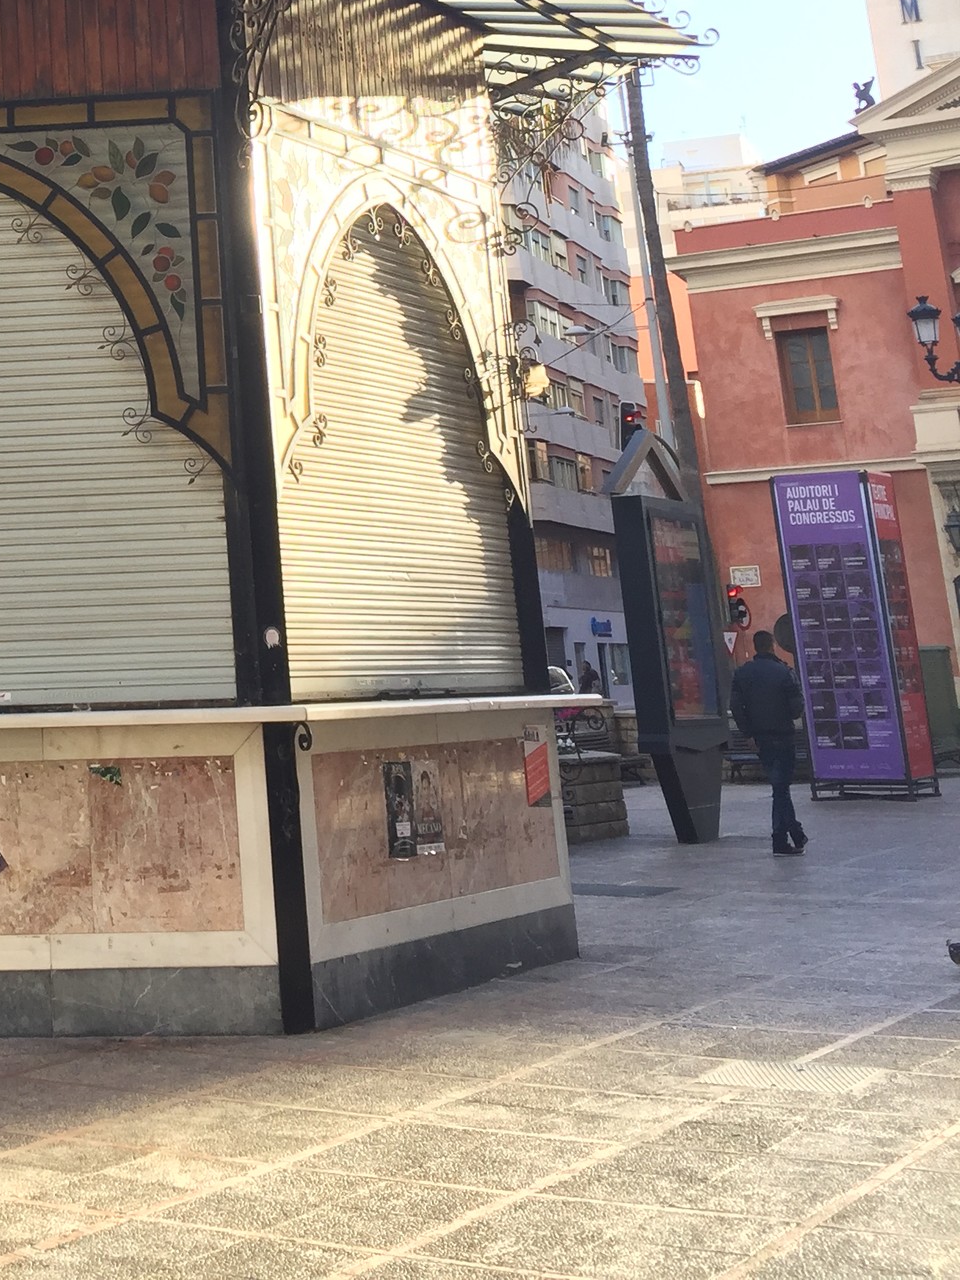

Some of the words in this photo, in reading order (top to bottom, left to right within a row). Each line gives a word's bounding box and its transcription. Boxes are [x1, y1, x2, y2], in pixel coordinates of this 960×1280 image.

[786, 484, 832, 499] AUDITORI
[787, 498, 820, 512] PALAU
[822, 497, 836, 510] DE
[789, 509, 856, 526] CONGRESSOS
